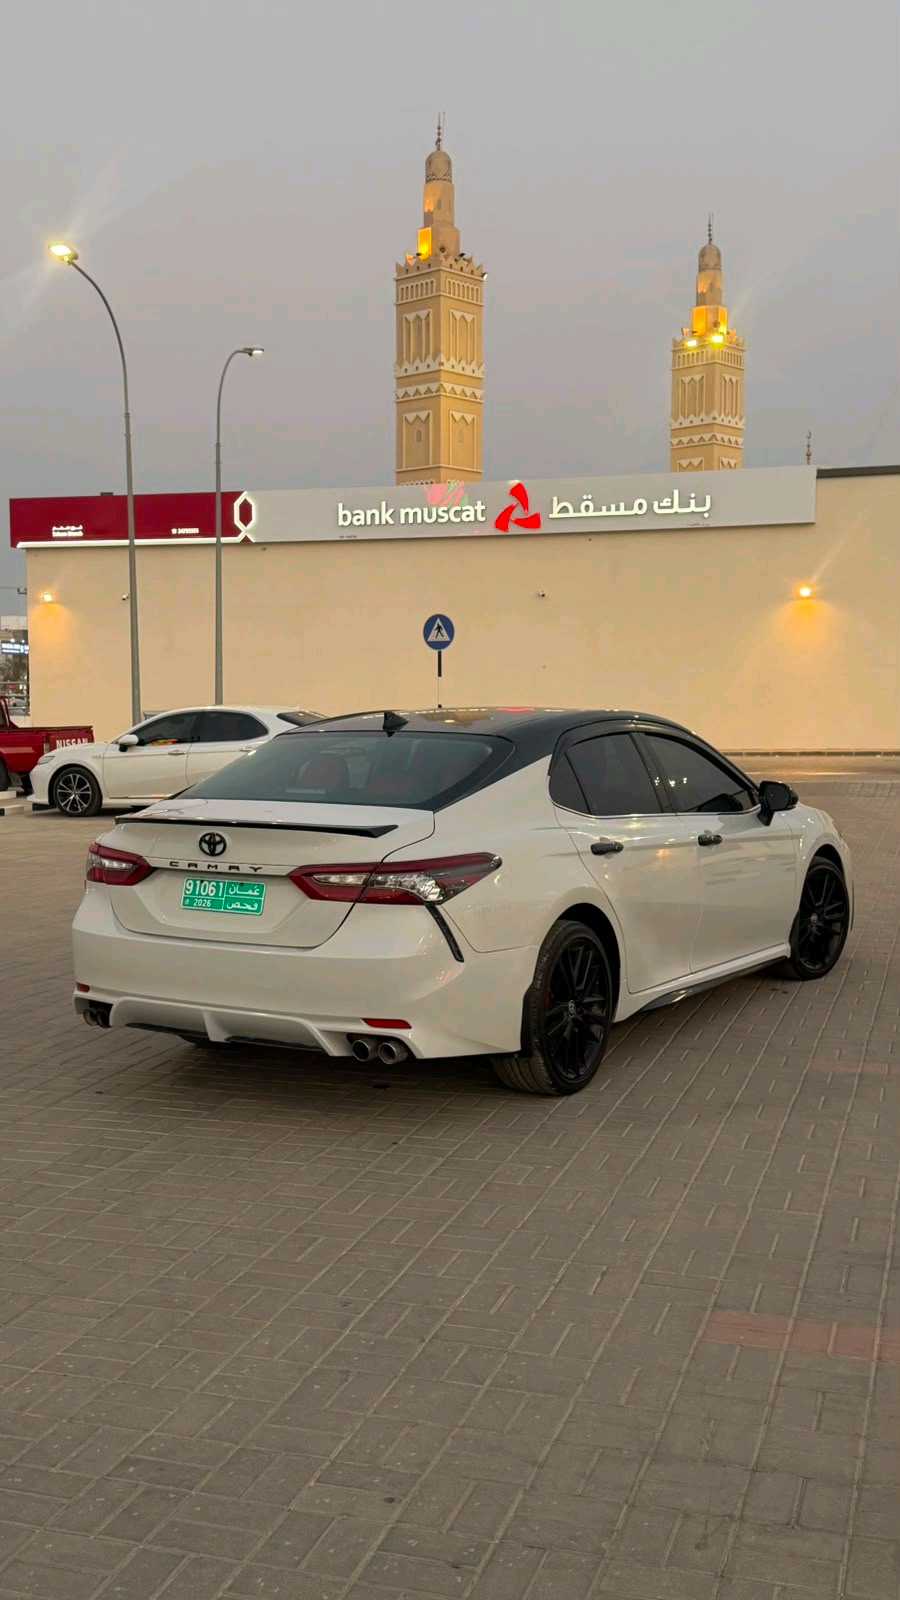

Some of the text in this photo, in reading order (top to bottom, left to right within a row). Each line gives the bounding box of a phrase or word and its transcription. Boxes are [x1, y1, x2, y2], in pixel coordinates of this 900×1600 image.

[337, 501, 486, 526] bank muscat
[549, 489, 712, 519] بنك مسقط
[169, 861, 263, 872] CAMRY
[185, 880, 224, 896] 91061
